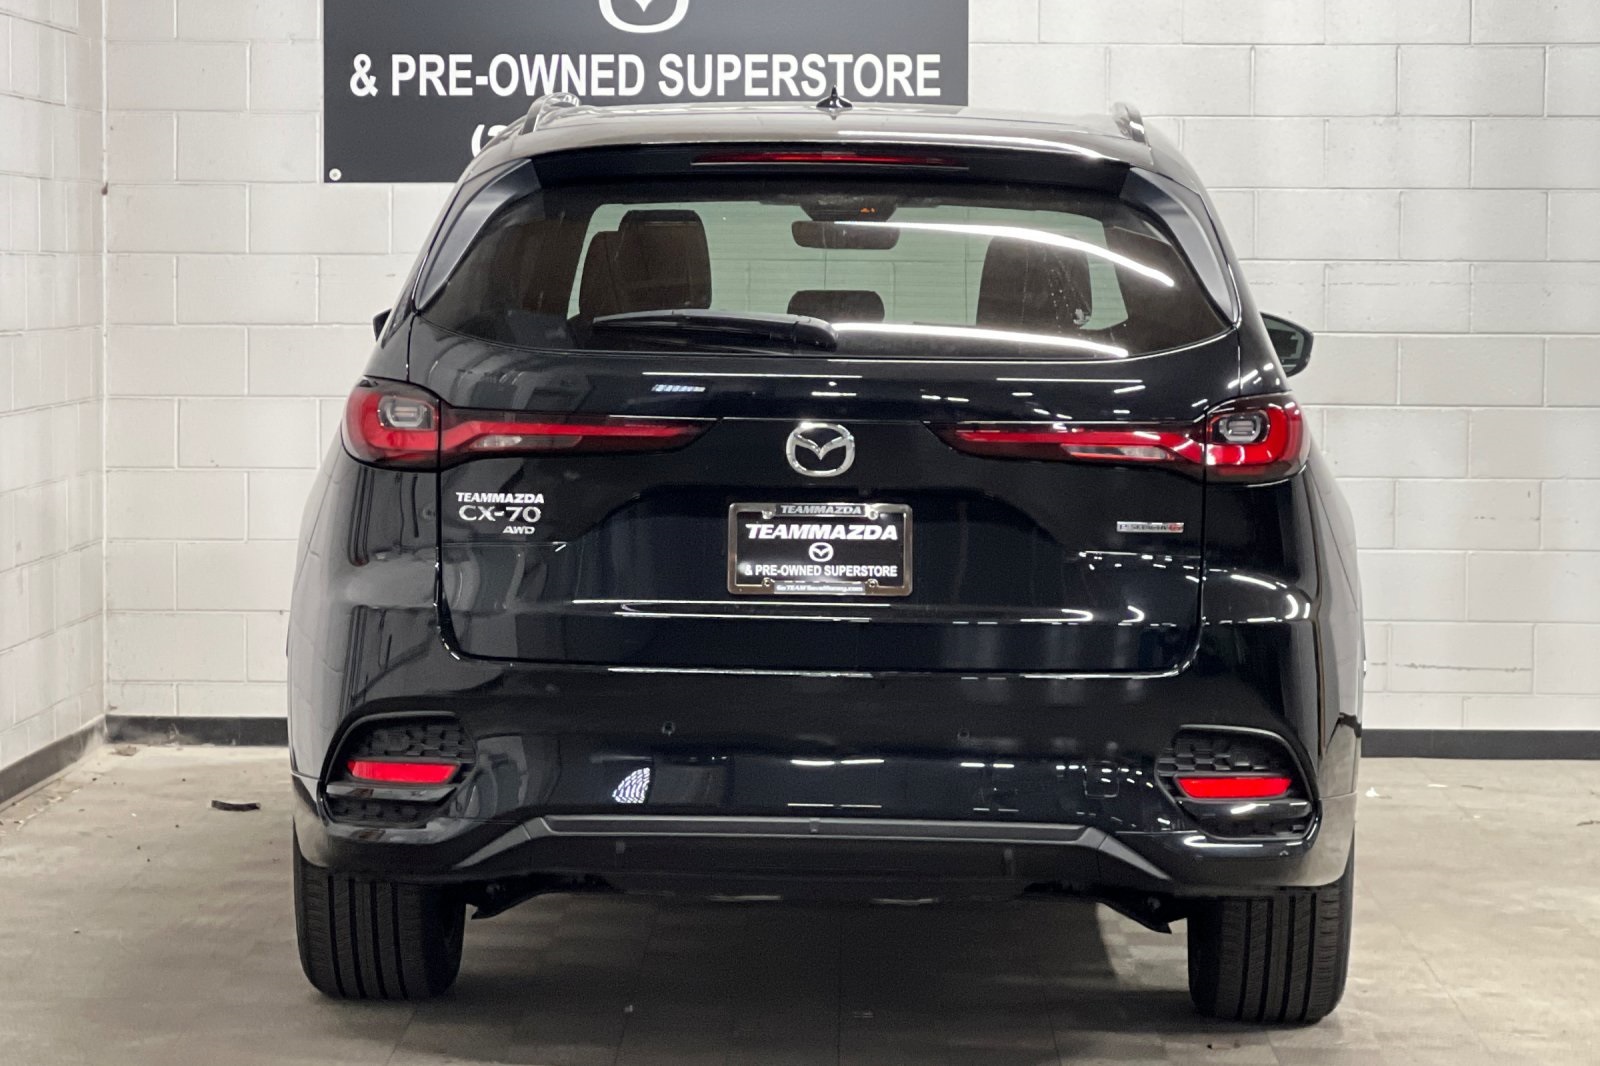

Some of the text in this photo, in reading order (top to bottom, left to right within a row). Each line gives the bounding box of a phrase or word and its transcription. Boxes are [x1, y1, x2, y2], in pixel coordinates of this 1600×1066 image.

[349, 52, 941, 98] & PRE-OWNED SUPERSTORE
[456, 492, 545, 504] TEAMMAZDA
[458, 505, 542, 523] CX-70
[780, 504, 862, 515] TEAMMAZDA
[502, 526, 536, 535] AWD
[745, 524, 898, 541] TEAMMAZDA
[755, 564, 822, 576] PRE-OWNED
[823, 565, 898, 577] SUPERSTORE
